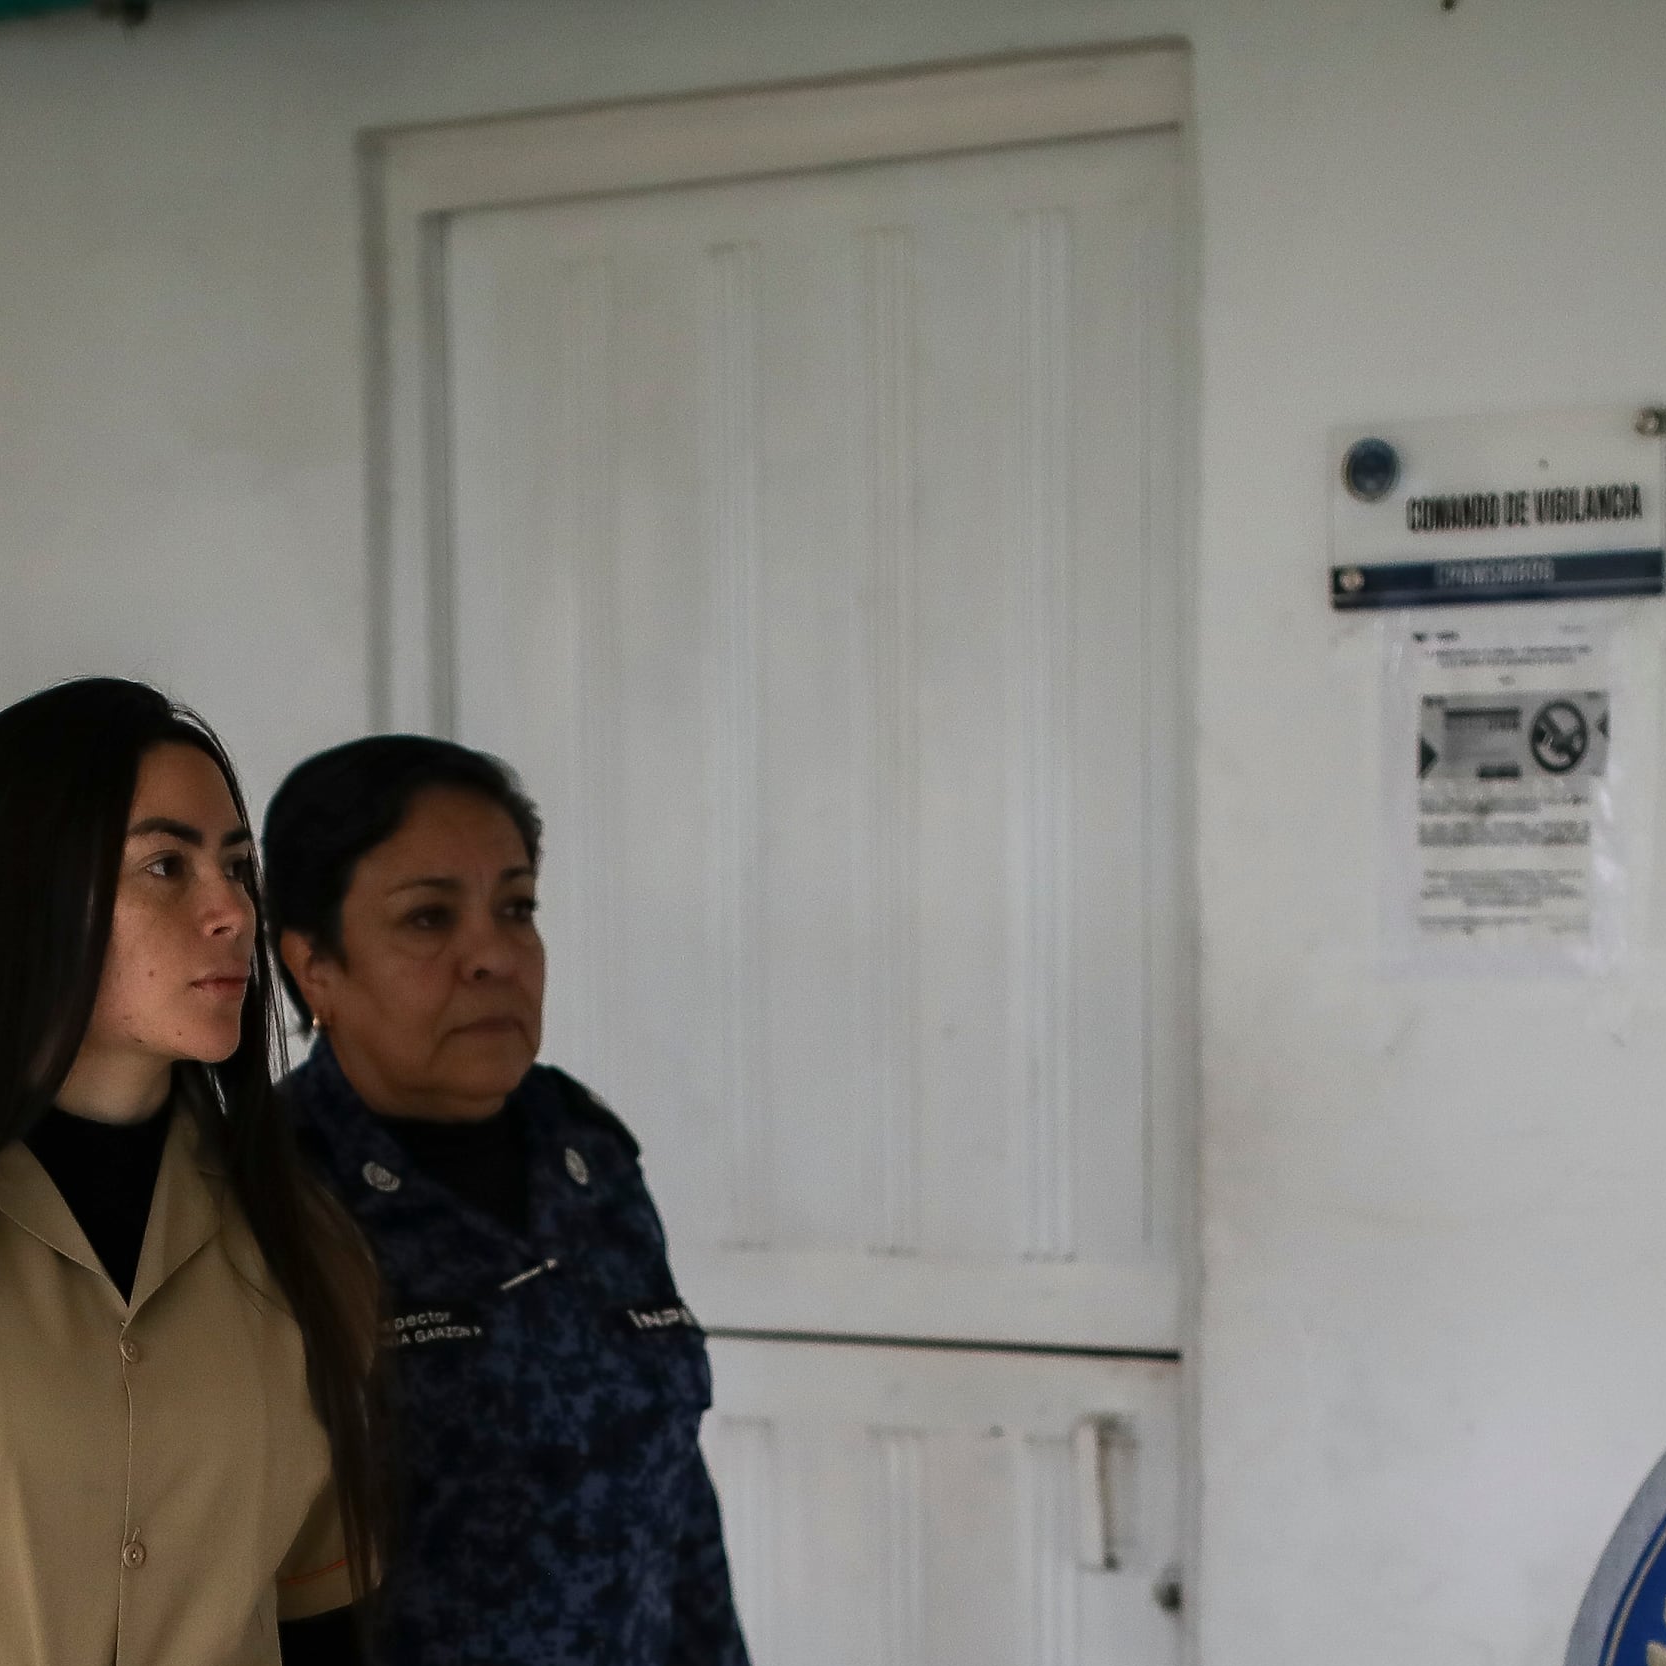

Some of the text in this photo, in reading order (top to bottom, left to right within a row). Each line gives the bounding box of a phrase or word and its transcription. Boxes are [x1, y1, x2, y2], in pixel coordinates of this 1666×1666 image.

[1406, 481, 1643, 532] COMANDO DE VIGILANCIA
